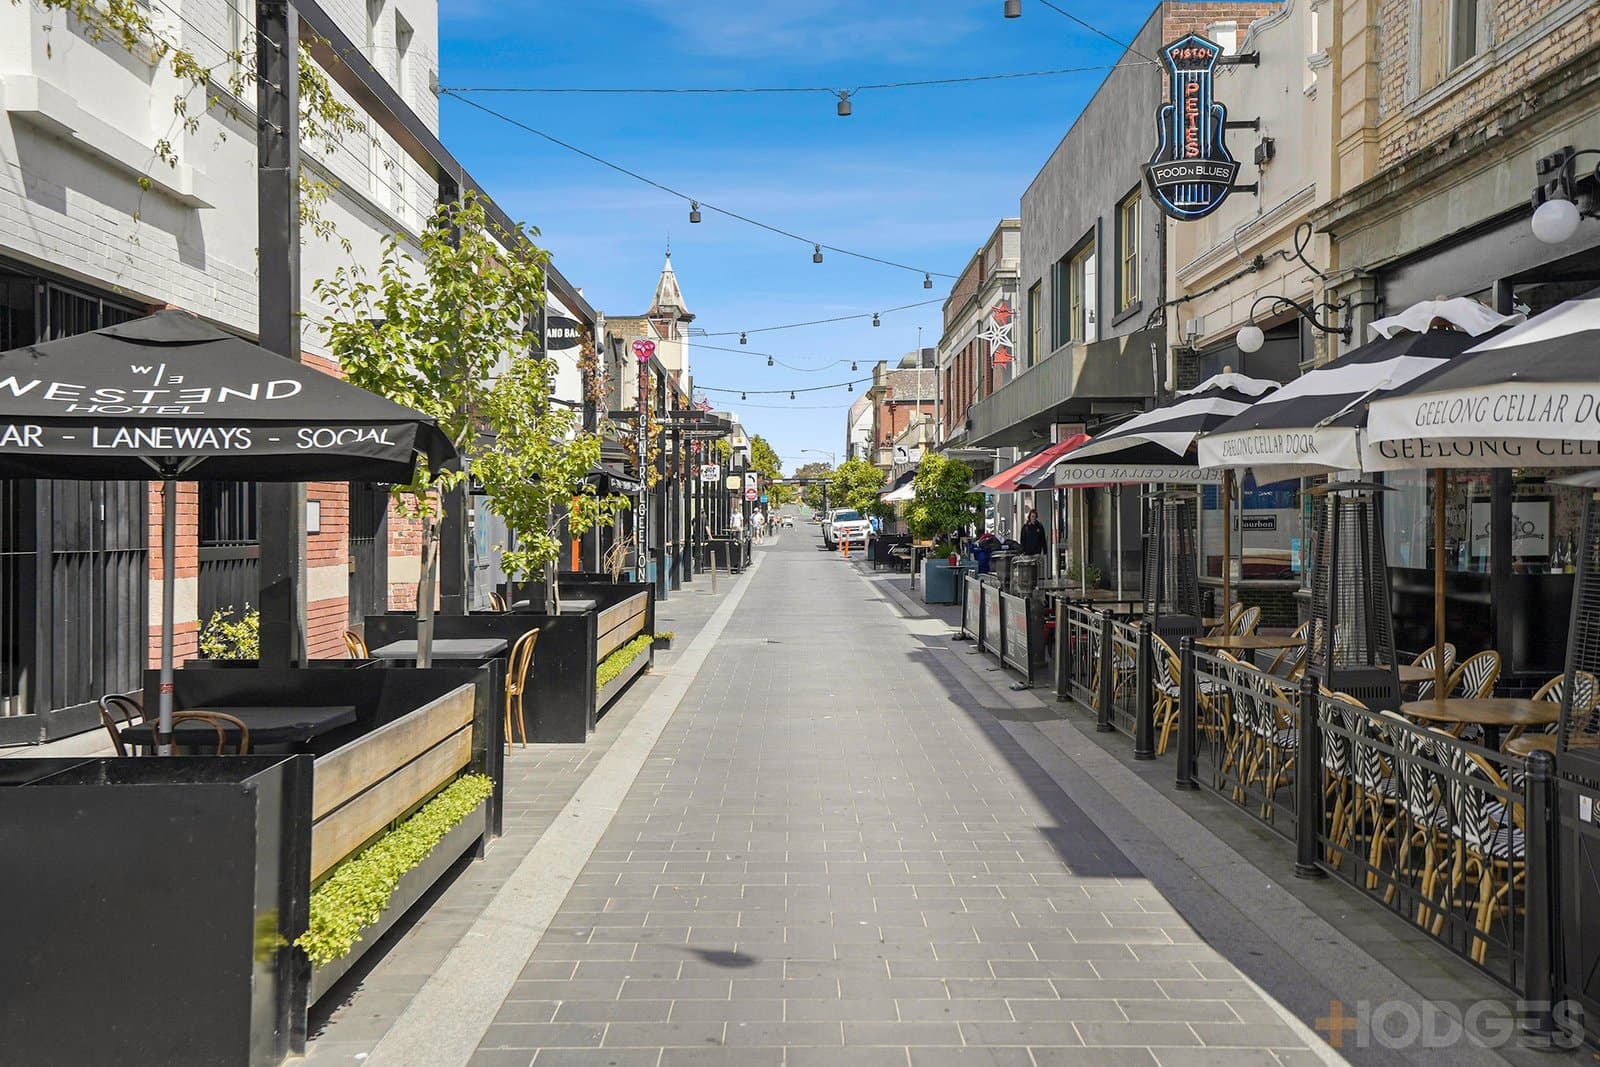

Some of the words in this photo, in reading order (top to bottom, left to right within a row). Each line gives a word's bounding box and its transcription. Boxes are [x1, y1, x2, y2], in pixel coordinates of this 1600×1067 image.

[1172, 48, 1212, 60] PISTOL
[1184, 82, 1200, 158] PETES
[1156, 165, 1188, 180] FOOD
[1187, 168, 1194, 176] N
[1195, 164, 1230, 178] BLUES
[65, 404, 205, 415] HOTEL
[1415, 396, 1490, 427] GEELONG
[1493, 394, 1569, 423] CELLAR
[1574, 393, 1600, 424] D
[0, 424, 44, 447] AR
[92, 426, 252, 450] LANEWAYS
[295, 428, 396, 449] SOCIAL
[1222, 435, 1253, 458] GEELONG
[1254, 434, 1284, 455] CELLAR
[1285, 433, 1320, 455] DOOR
[1379, 437, 1521, 459] GEELONG
[1536, 438, 1600, 456] CEL
[1241, 519, 1274, 529] ourbon
[638, 503, 646, 583] GEELON
